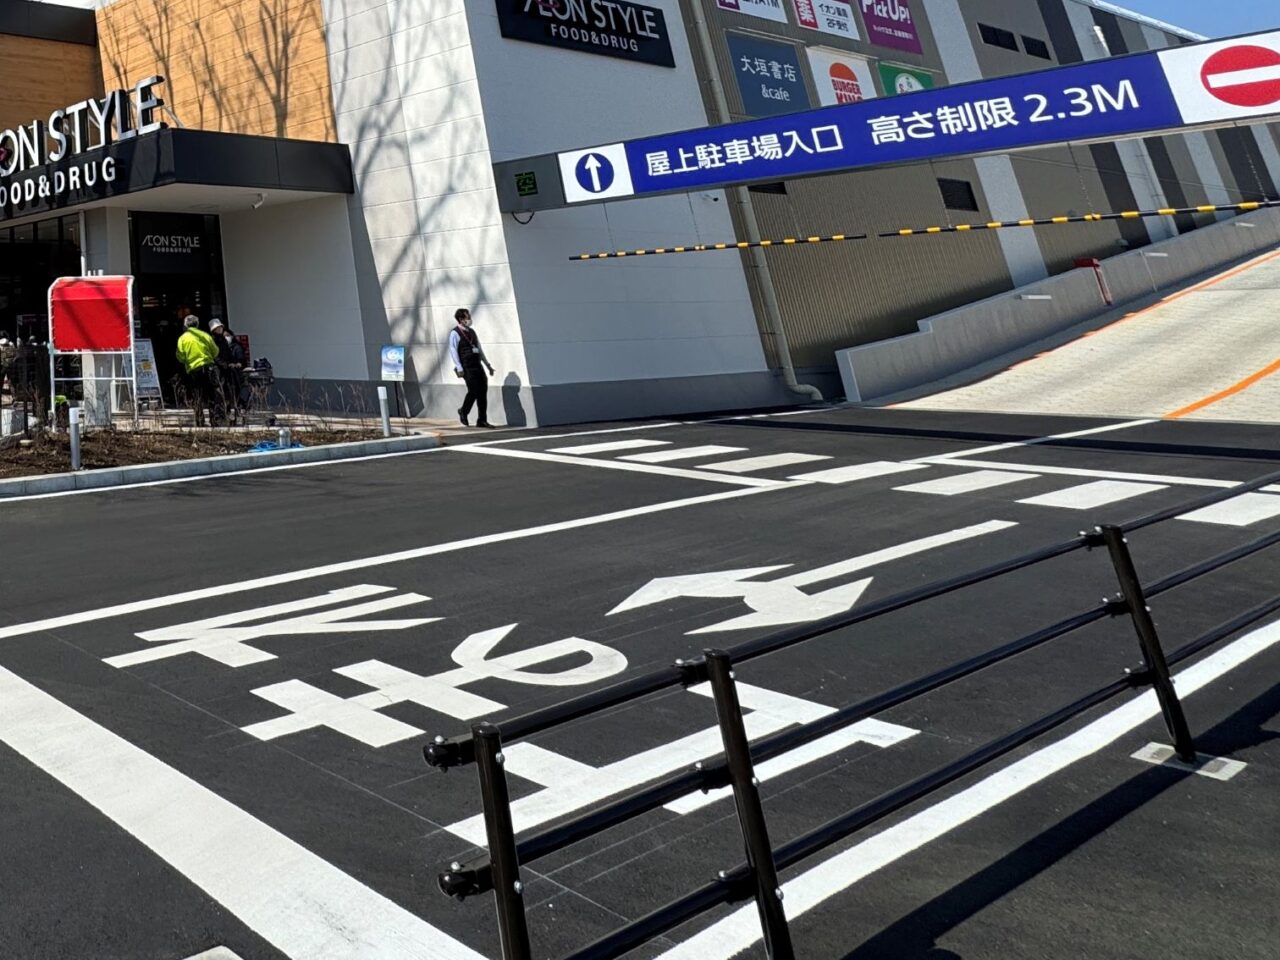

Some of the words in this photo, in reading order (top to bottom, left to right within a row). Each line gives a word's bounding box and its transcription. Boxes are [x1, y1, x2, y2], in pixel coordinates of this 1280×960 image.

[550, 23, 639, 52] FOOD&DRUG
[740, 55, 797, 82] 大垣書店
[761, 84, 790, 101] &cafe
[831, 78, 862, 96] BURGER
[49, 75, 165, 162] STYLE
[646, 125, 844, 176] 屋上駐車場入口
[867, 96, 1019, 146] 高さ制限
[1023, 79, 1140, 123] 2.3M
[170, 236, 200, 248] STYLE
